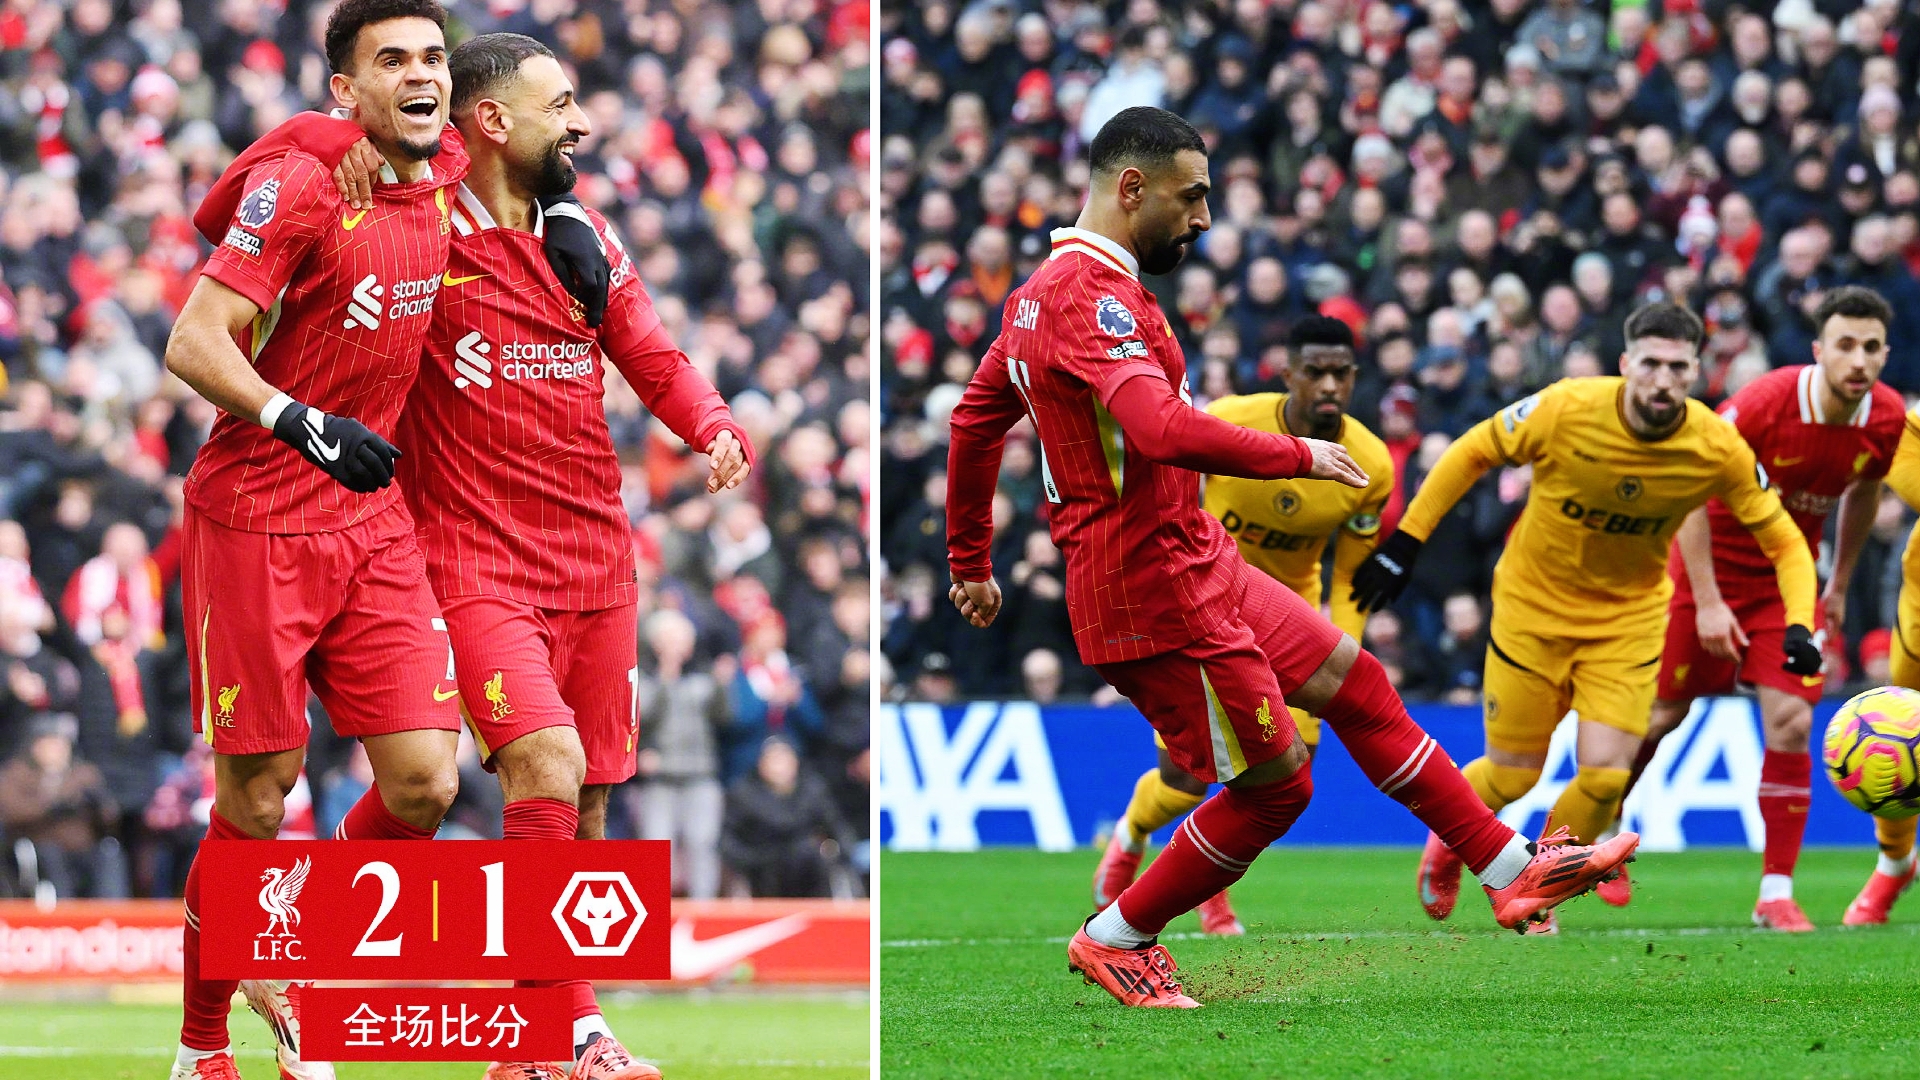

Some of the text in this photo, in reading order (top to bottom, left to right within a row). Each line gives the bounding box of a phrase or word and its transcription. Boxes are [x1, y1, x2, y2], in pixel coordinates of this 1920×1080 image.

[609, 250, 632, 288] Exp
[389, 292, 437, 320] charte
[501, 340, 595, 360] standard
[502, 355, 593, 380] chartered
[1562, 499, 1670, 536] DEBET
